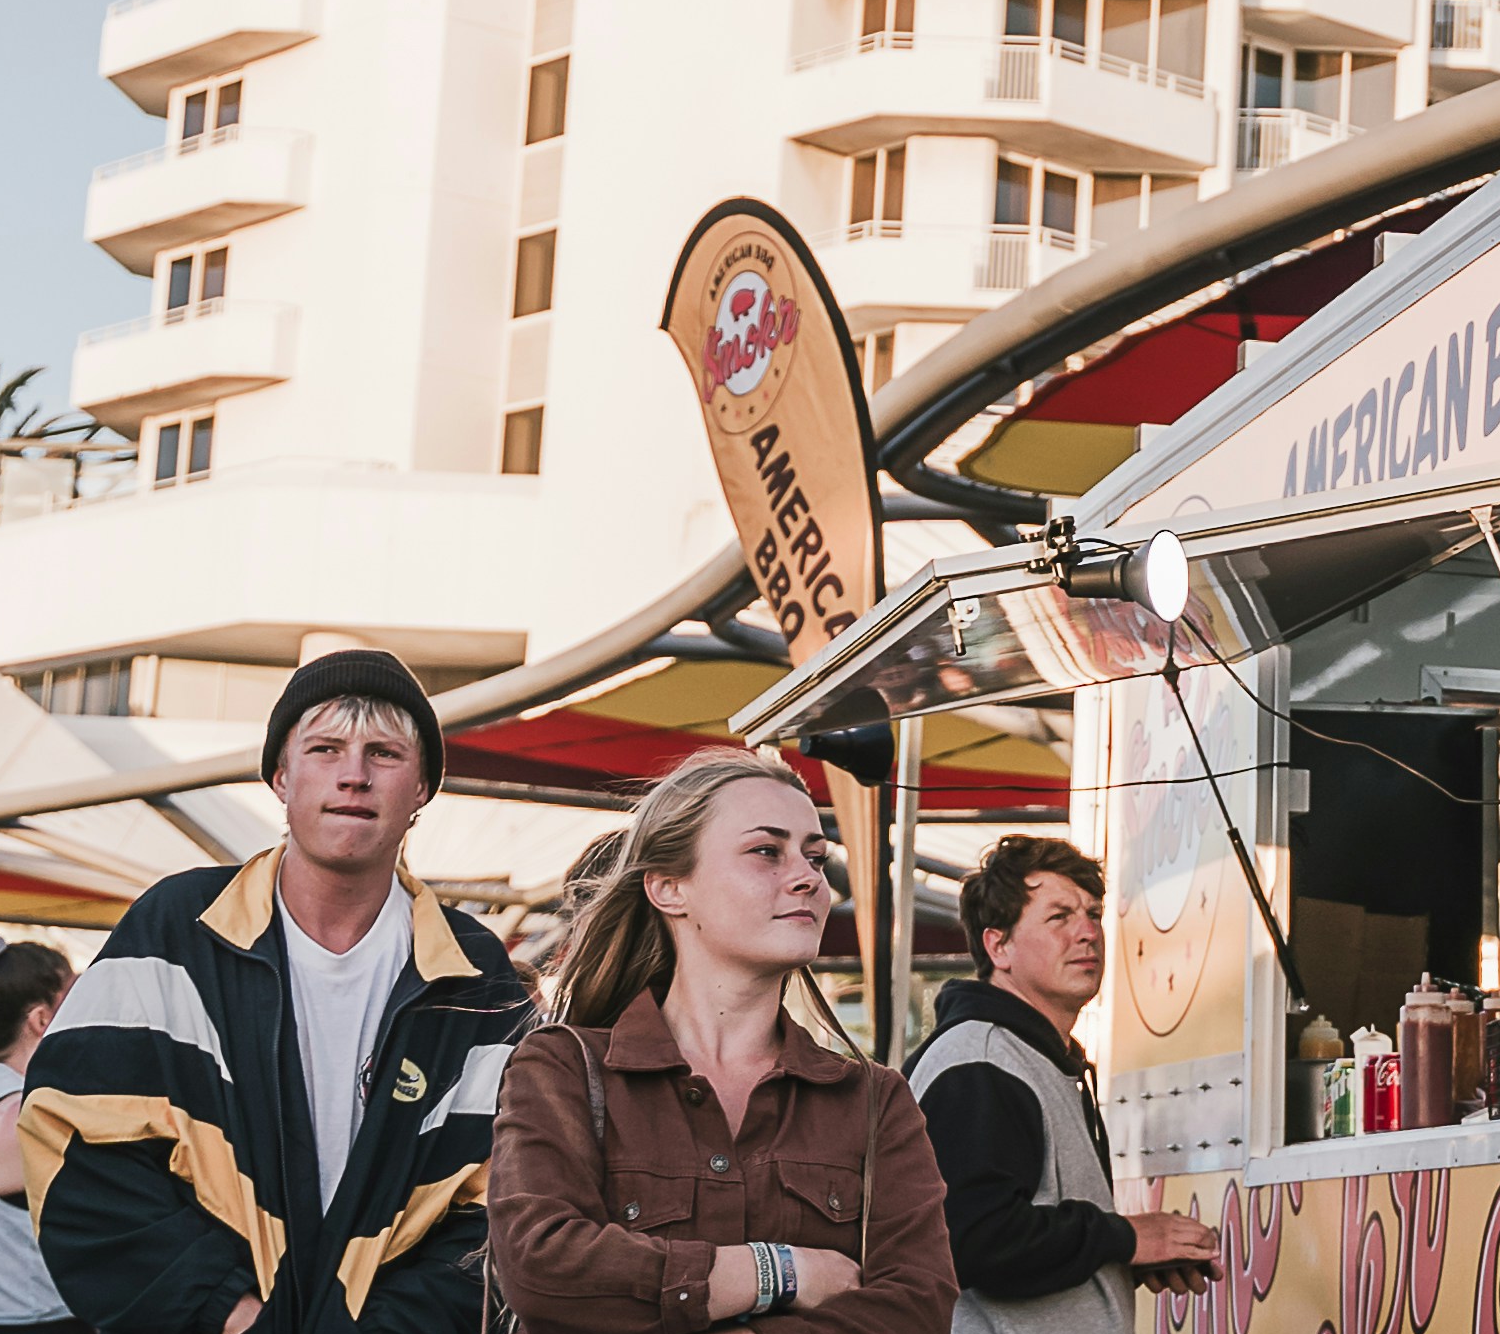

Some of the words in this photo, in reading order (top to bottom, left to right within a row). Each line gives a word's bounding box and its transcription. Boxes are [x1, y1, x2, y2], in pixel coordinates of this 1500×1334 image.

[703, 289, 801, 403] Smokr
[1283, 322, 1474, 498] AMERICAN
[750, 424, 857, 641] AMERICA
